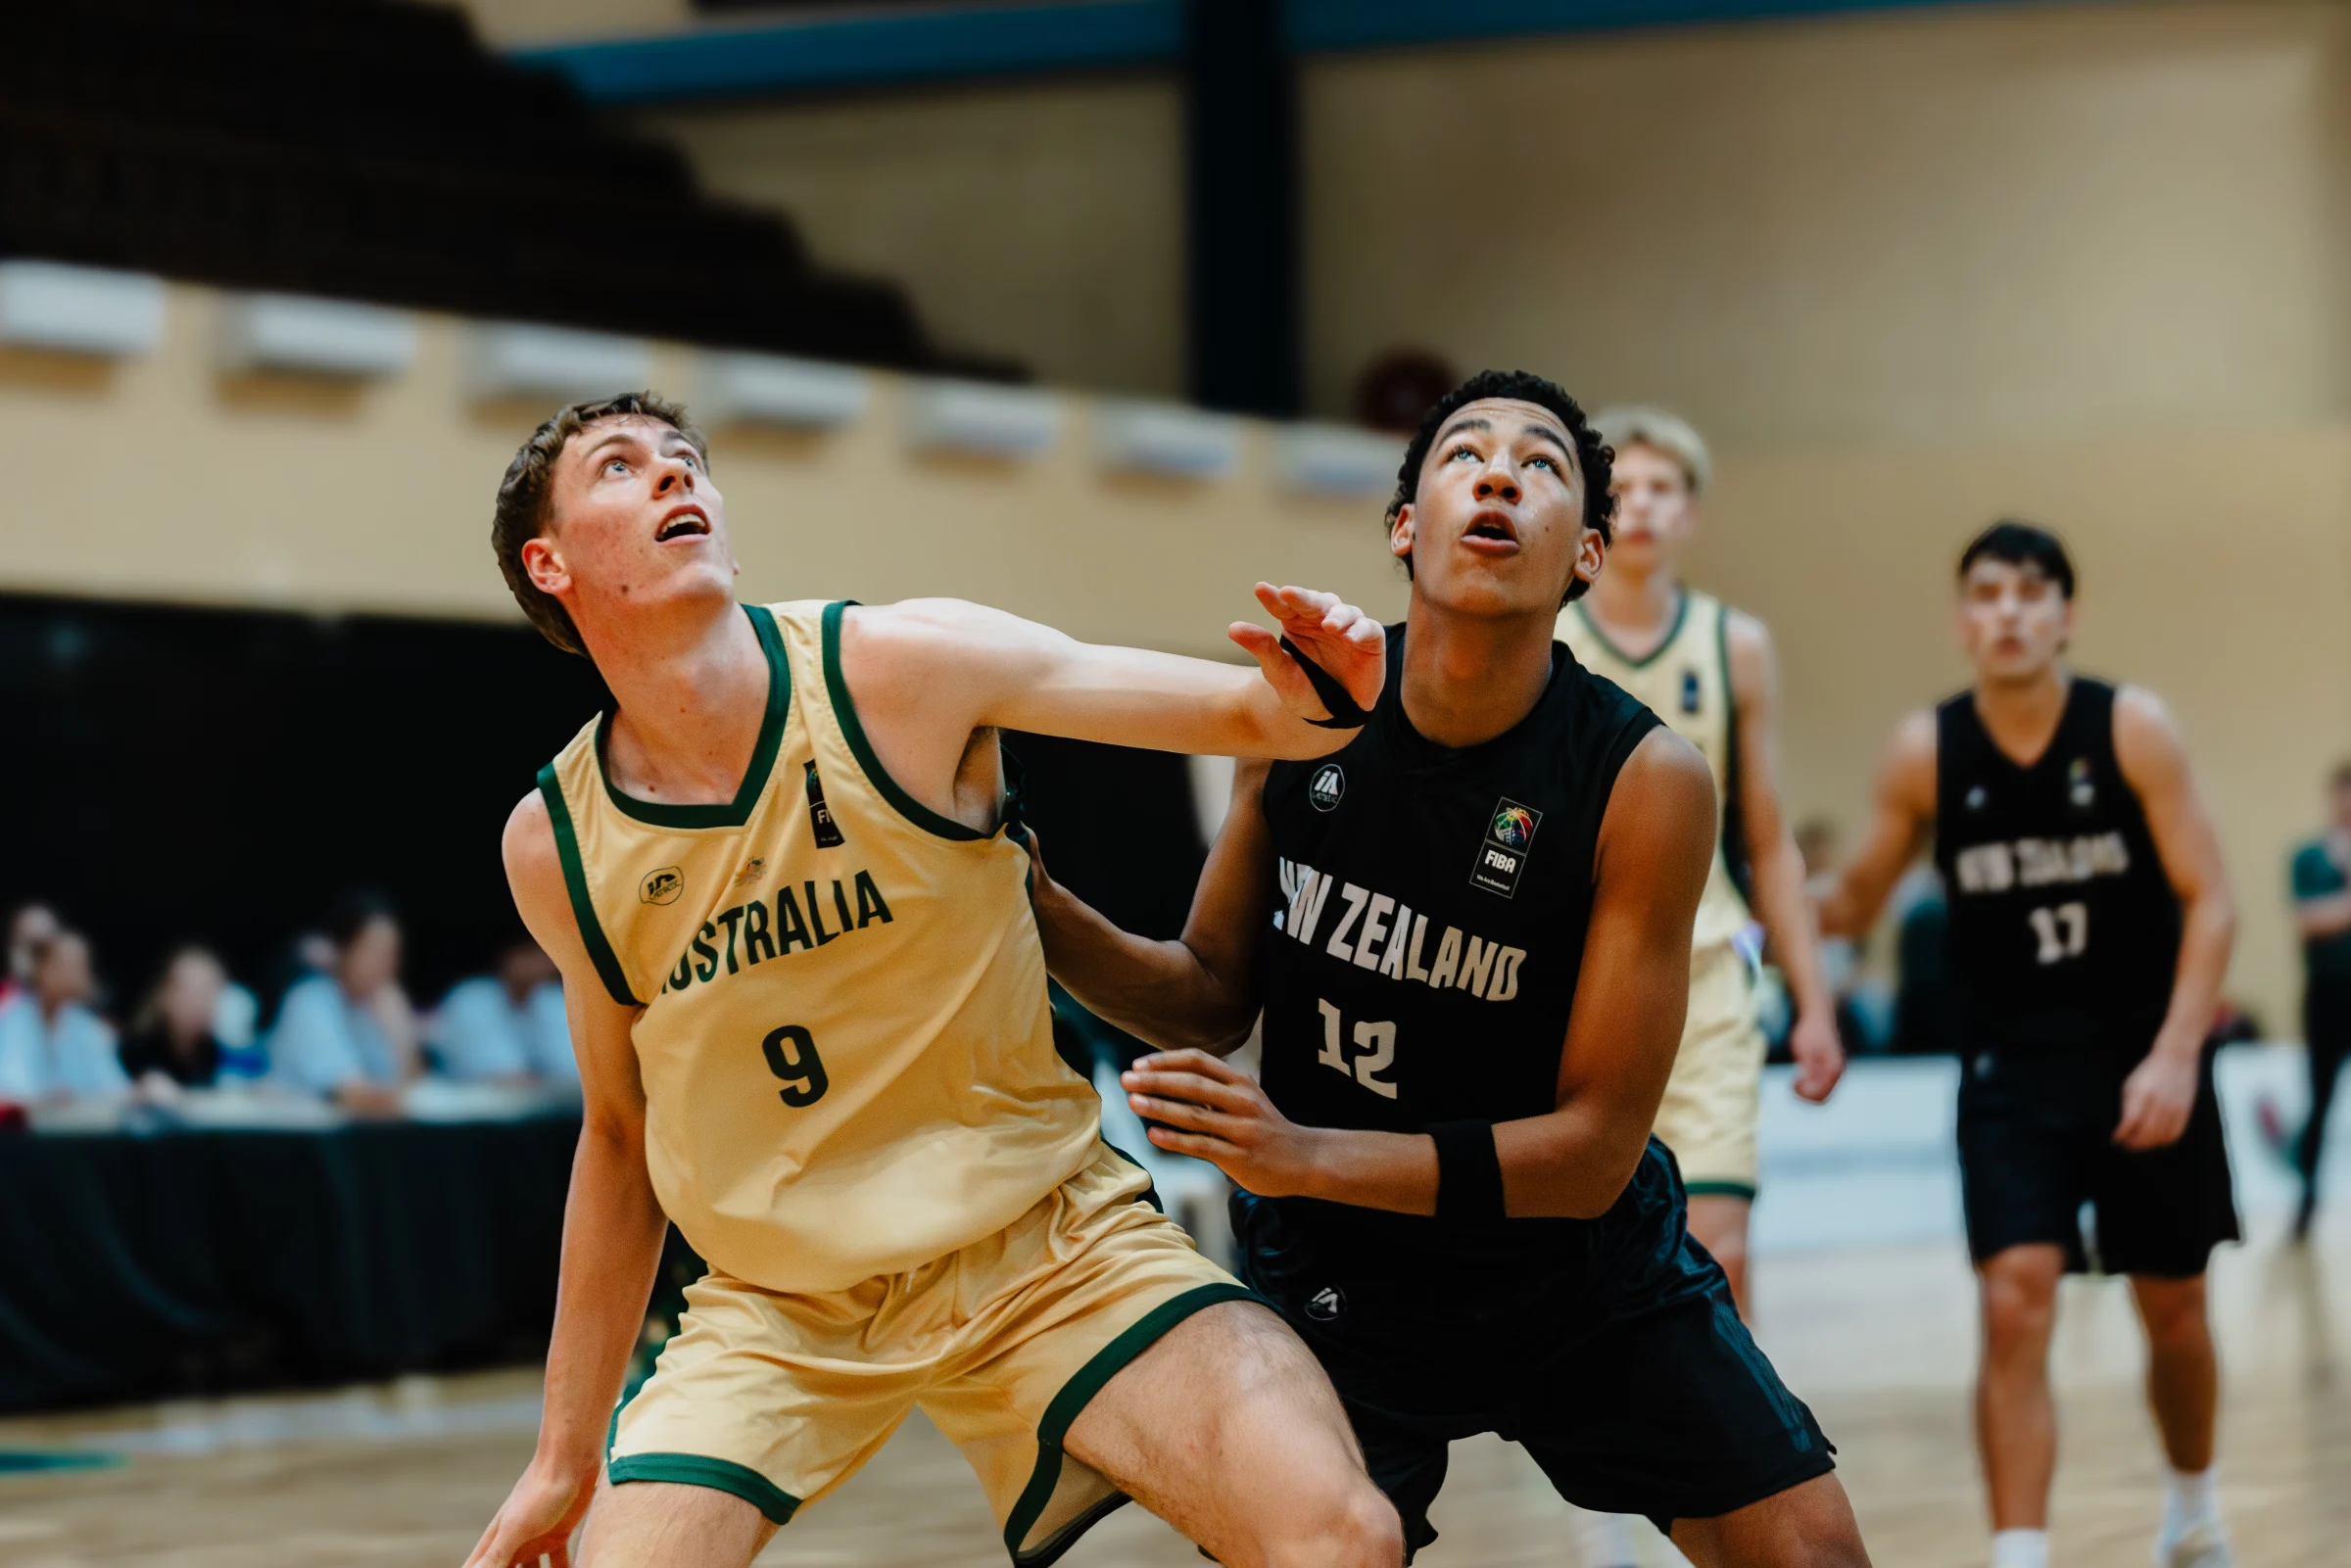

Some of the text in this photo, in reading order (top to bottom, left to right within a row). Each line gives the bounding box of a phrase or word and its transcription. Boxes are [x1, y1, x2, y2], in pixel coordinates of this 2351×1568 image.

[1484, 849, 1516, 874] FIBA
[661, 870, 893, 995] USTRALIA
[1326, 882, 1527, 1001] ZEALAND
[2030, 902, 2087, 964] 17
[762, 1024, 829, 1108] 9
[1319, 998, 1397, 1099] 12
